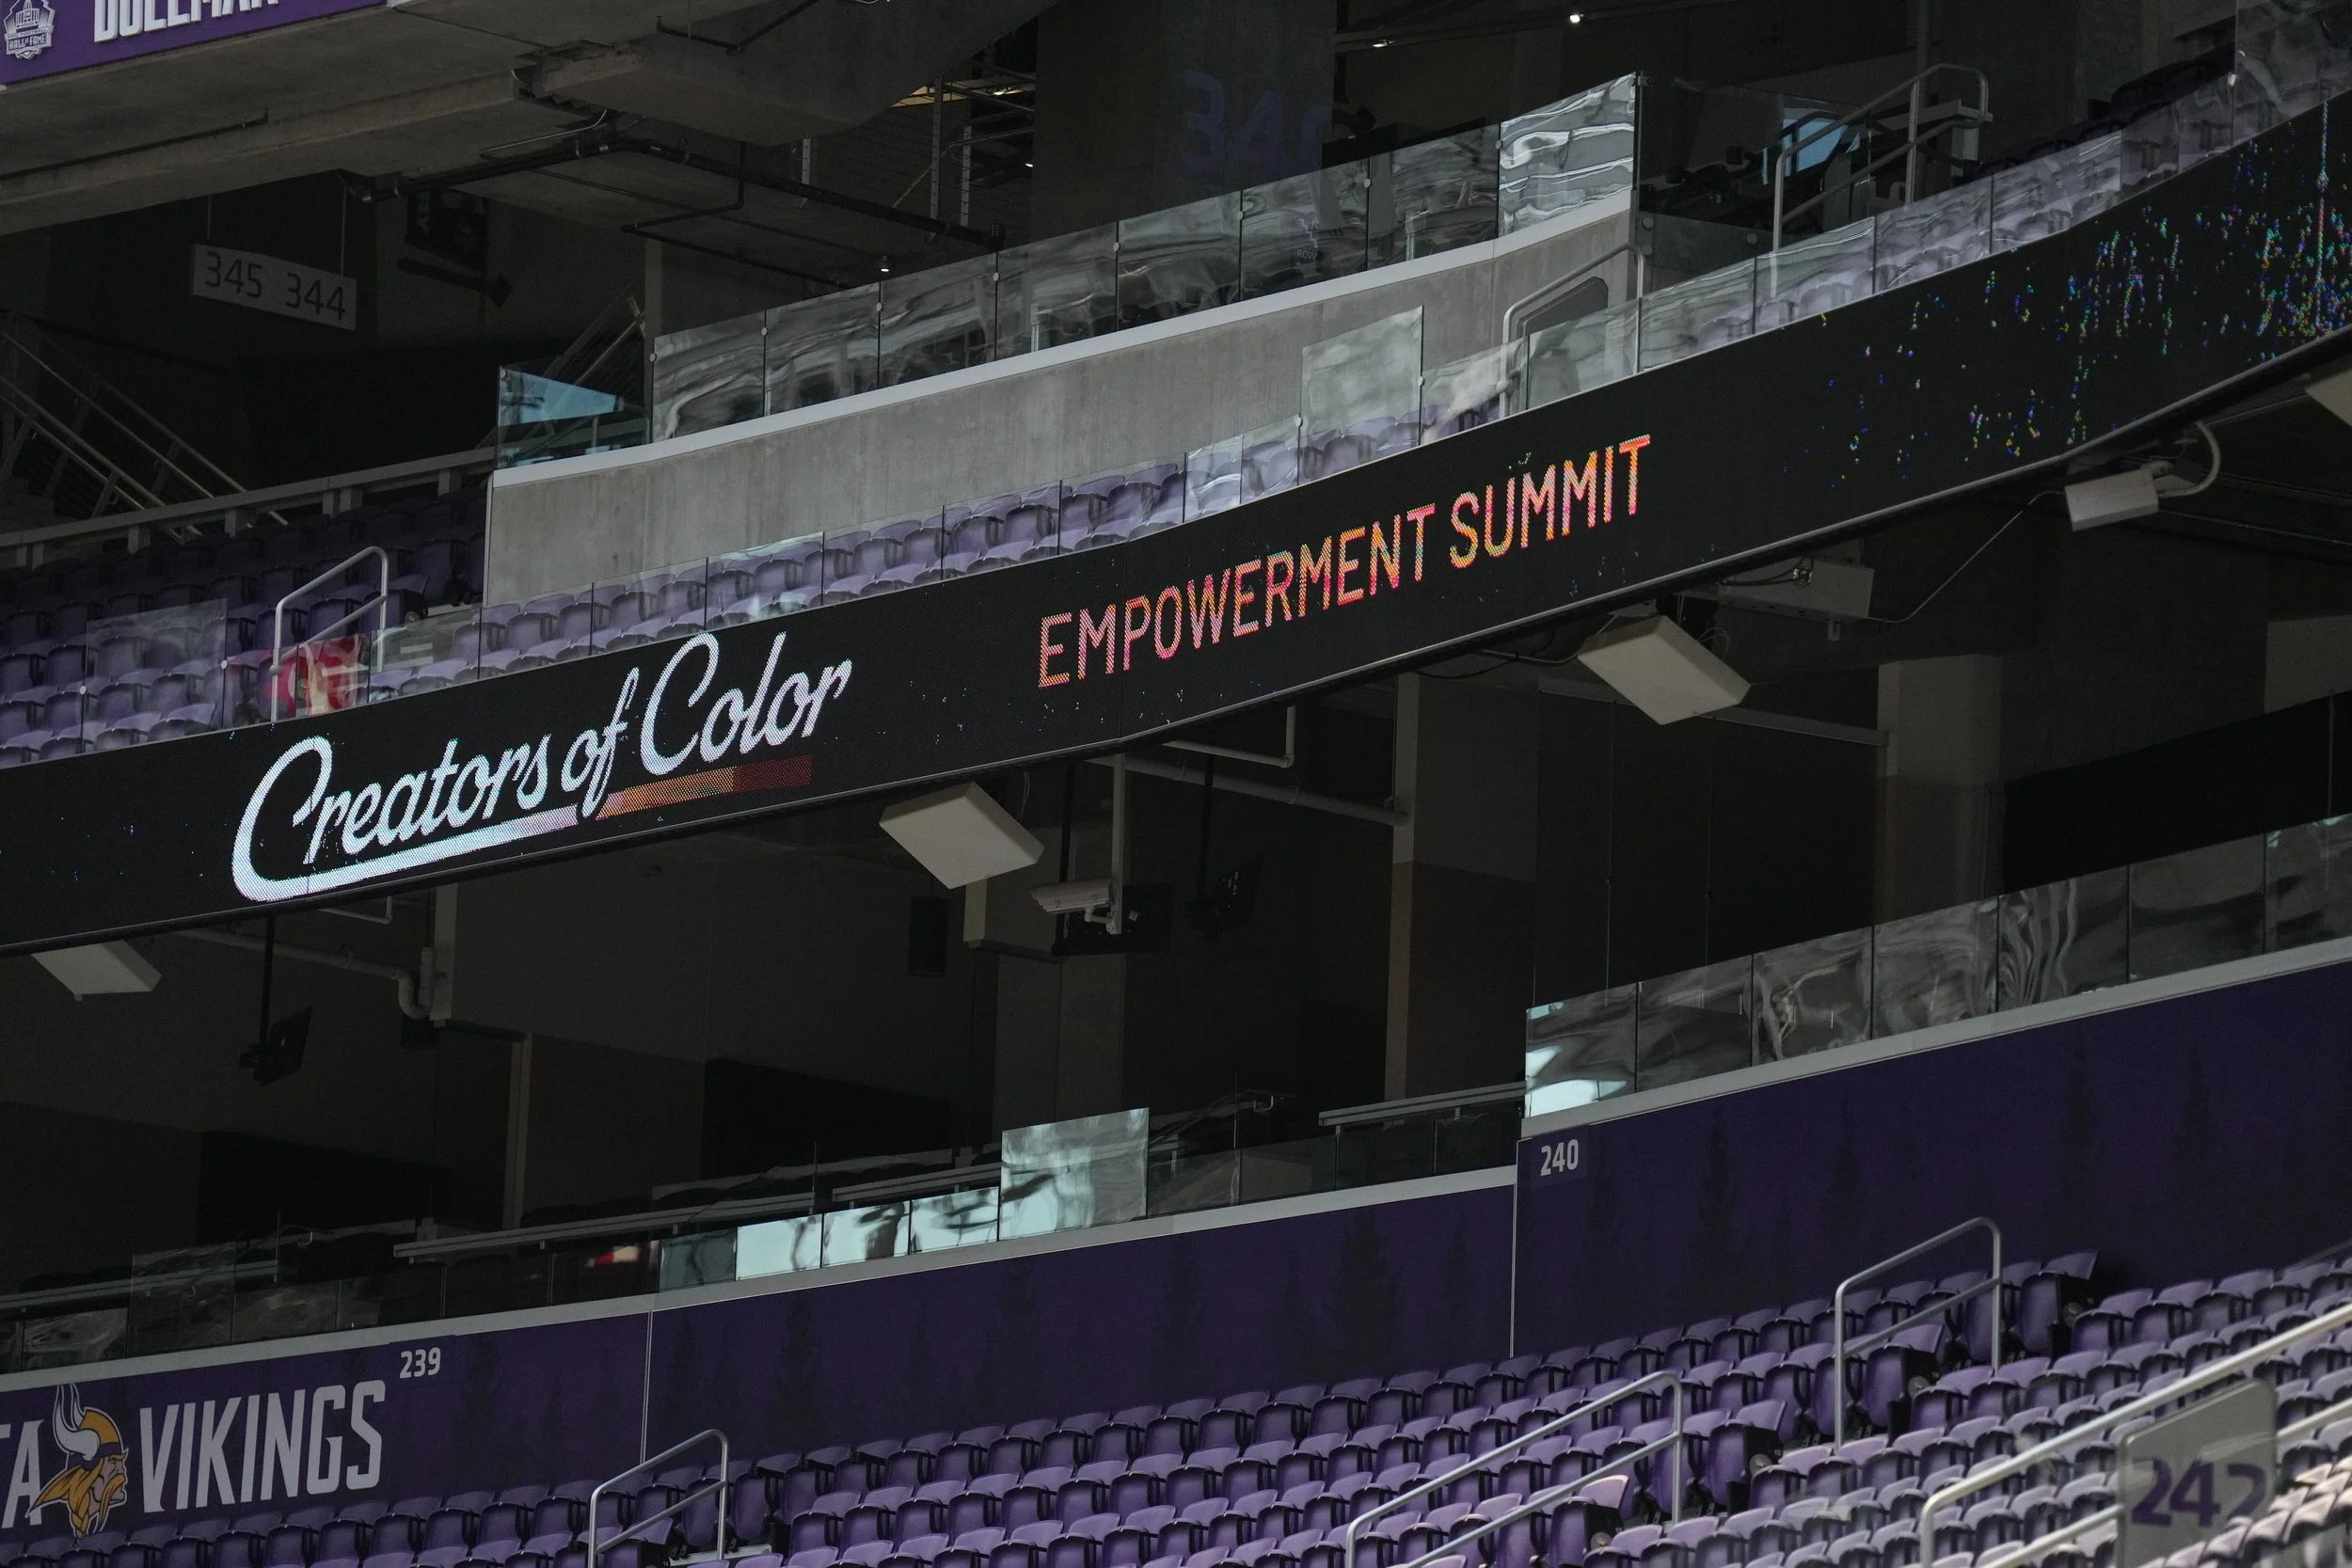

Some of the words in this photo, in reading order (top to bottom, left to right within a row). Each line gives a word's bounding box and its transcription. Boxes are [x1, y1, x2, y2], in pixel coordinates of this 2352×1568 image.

[205, 251, 263, 298] 345
[285, 272, 347, 321] 344
[1038, 502, 1436, 689] EMPOWERMENT
[1449, 434, 1650, 569] SUMMIT
[231, 735, 557, 902] Creators
[562, 666, 640, 817] of
[640, 631, 852, 776] Color
[1540, 1138, 1580, 1177] 240
[399, 1346, 441, 1379] 239
[139, 1379, 386, 1513] VIKINGS
[2132, 1456, 2266, 1528] 242
